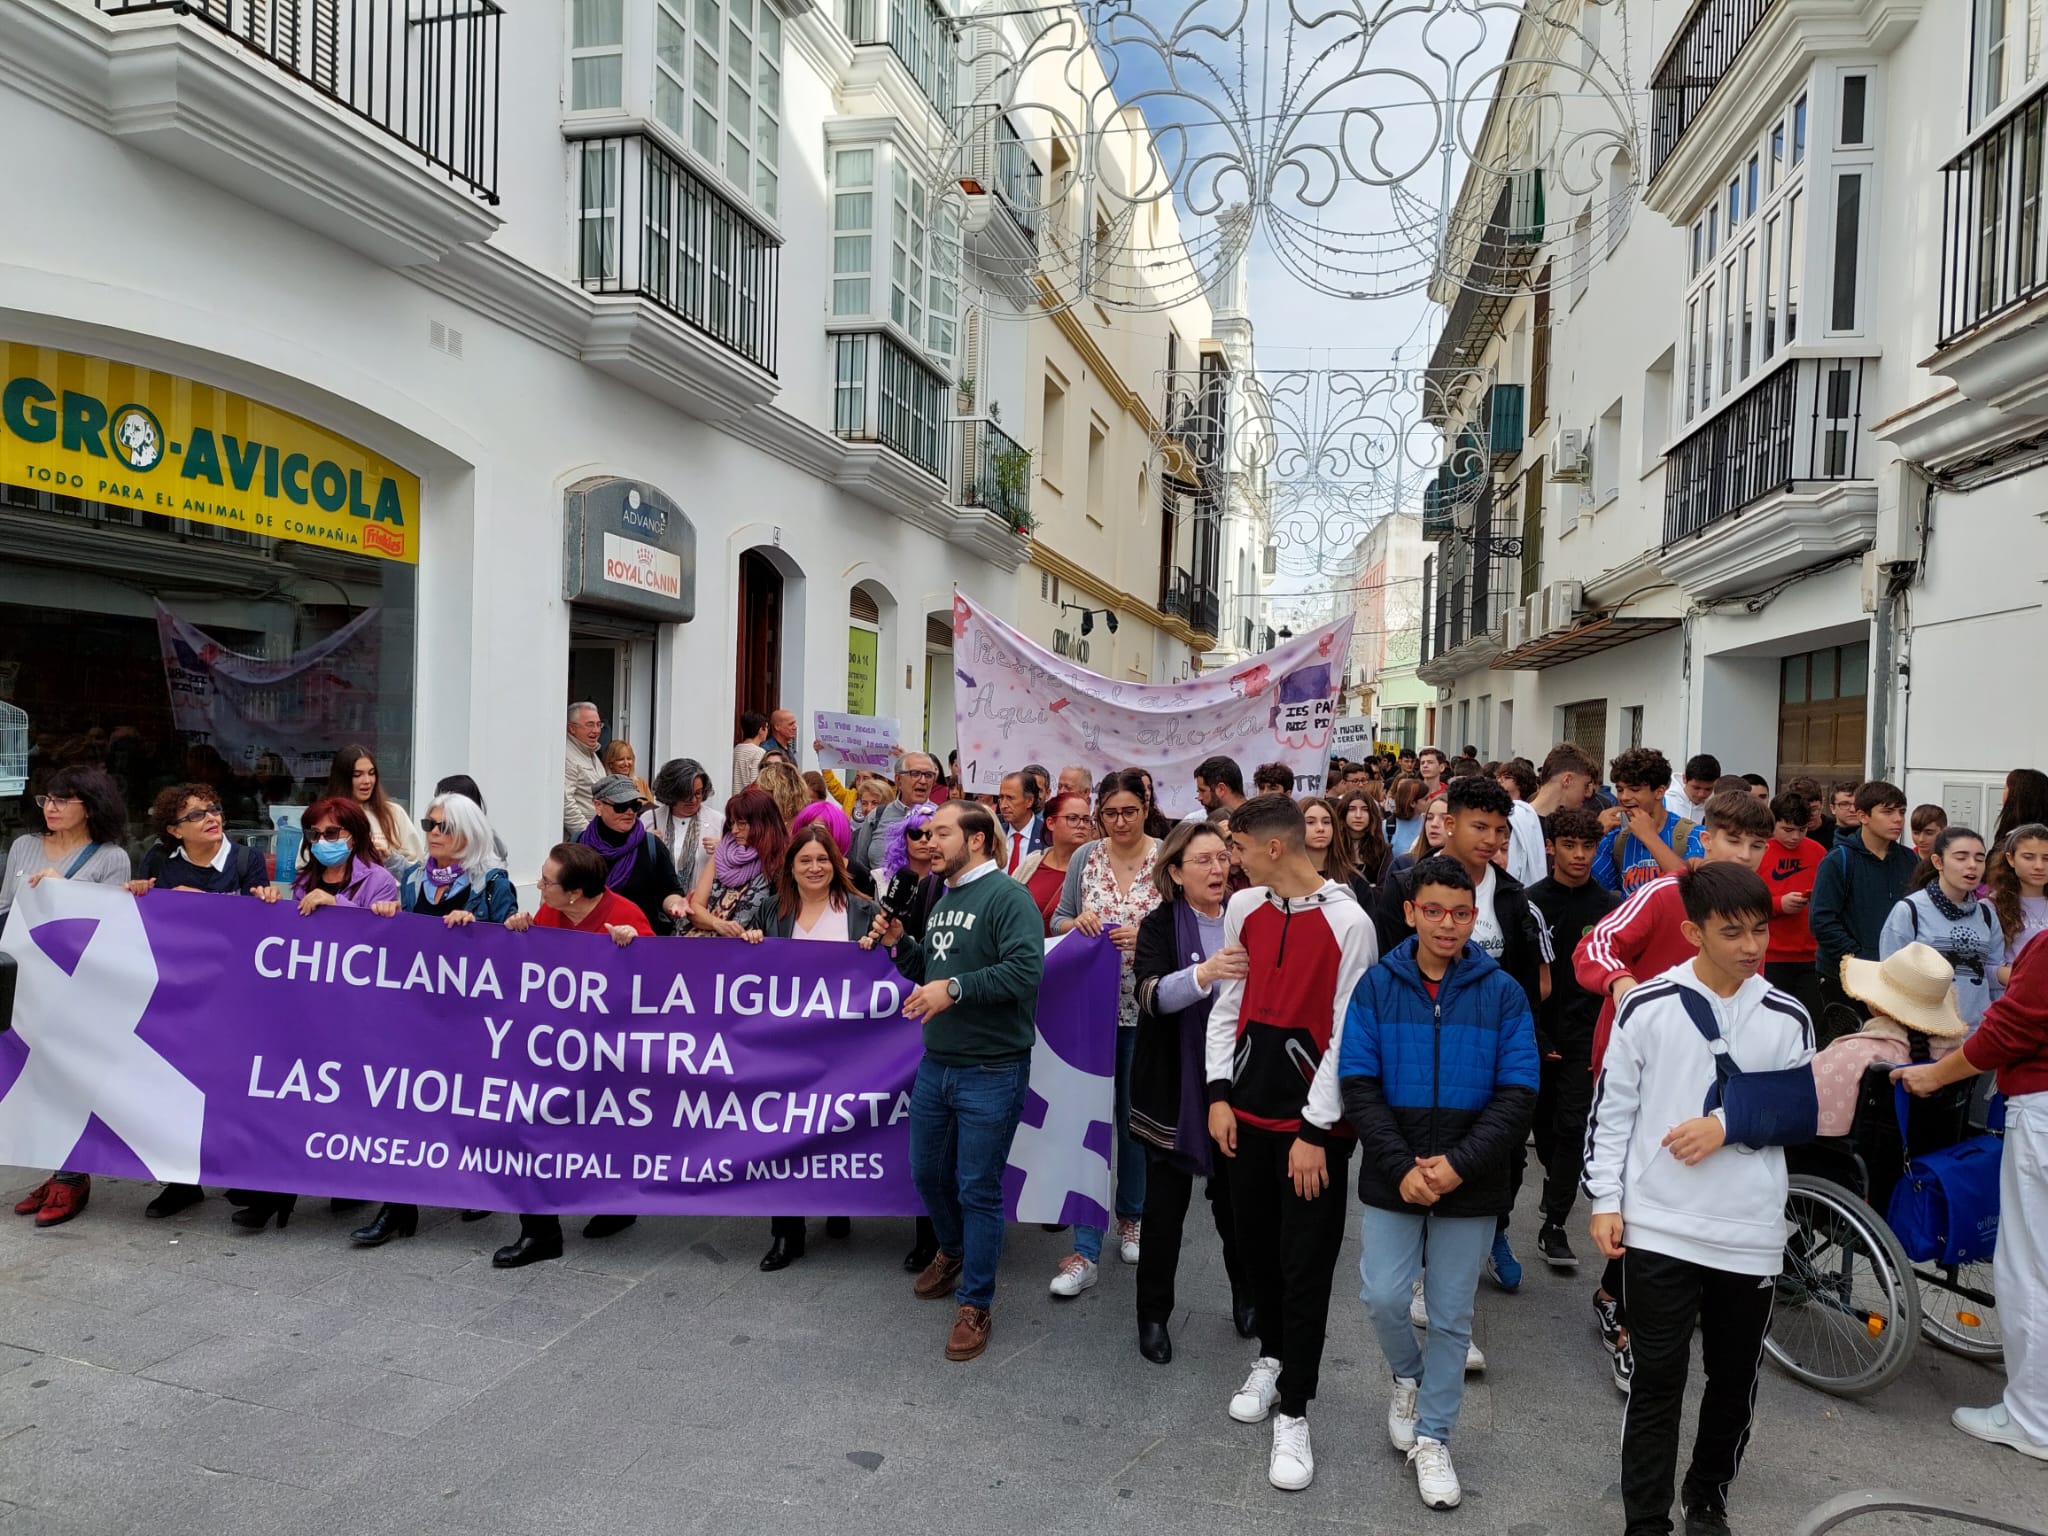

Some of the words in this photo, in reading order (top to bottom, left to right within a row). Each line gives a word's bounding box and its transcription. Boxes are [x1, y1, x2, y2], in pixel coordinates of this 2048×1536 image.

[0, 377, 404, 526] GRO-AVICOLA
[27, 465, 84, 488] TODO
[99, 480, 144, 501] PARA
[156, 492, 174, 507] EL
[183, 498, 246, 521] ANIMAL
[255, 513, 273, 527] DE
[284, 519, 358, 545] COMPAÑIA
[622, 509, 666, 536] ADVANCE
[607, 558, 642, 585] ROYAL
[646, 570, 678, 594] CANIN
[1285, 705, 1309, 717] IES
[1286, 720, 1308, 732] RUIZ
[1315, 718, 1330, 729] PI
[1340, 724, 1365, 735] MUJER
[1778, 858, 1800, 871] NIKE
[254, 936, 504, 1000] CHICLANA
[519, 962, 609, 1014] POR
[631, 973, 696, 1014] LA
[714, 973, 902, 1019] IGUALD
[484, 1017, 513, 1059] Y
[527, 1025, 734, 1075] CONTRA
[248, 1056, 342, 1103] LAS
[363, 1064, 653, 1127] VIOLENCIAS
[305, 1132, 449, 1169] CONSEJO
[458, 1146, 621, 1180] MUNICIPAL
[632, 1154, 672, 1181] DE
[680, 1156, 733, 1183] LAS
[745, 1153, 884, 1181] MUJERES
